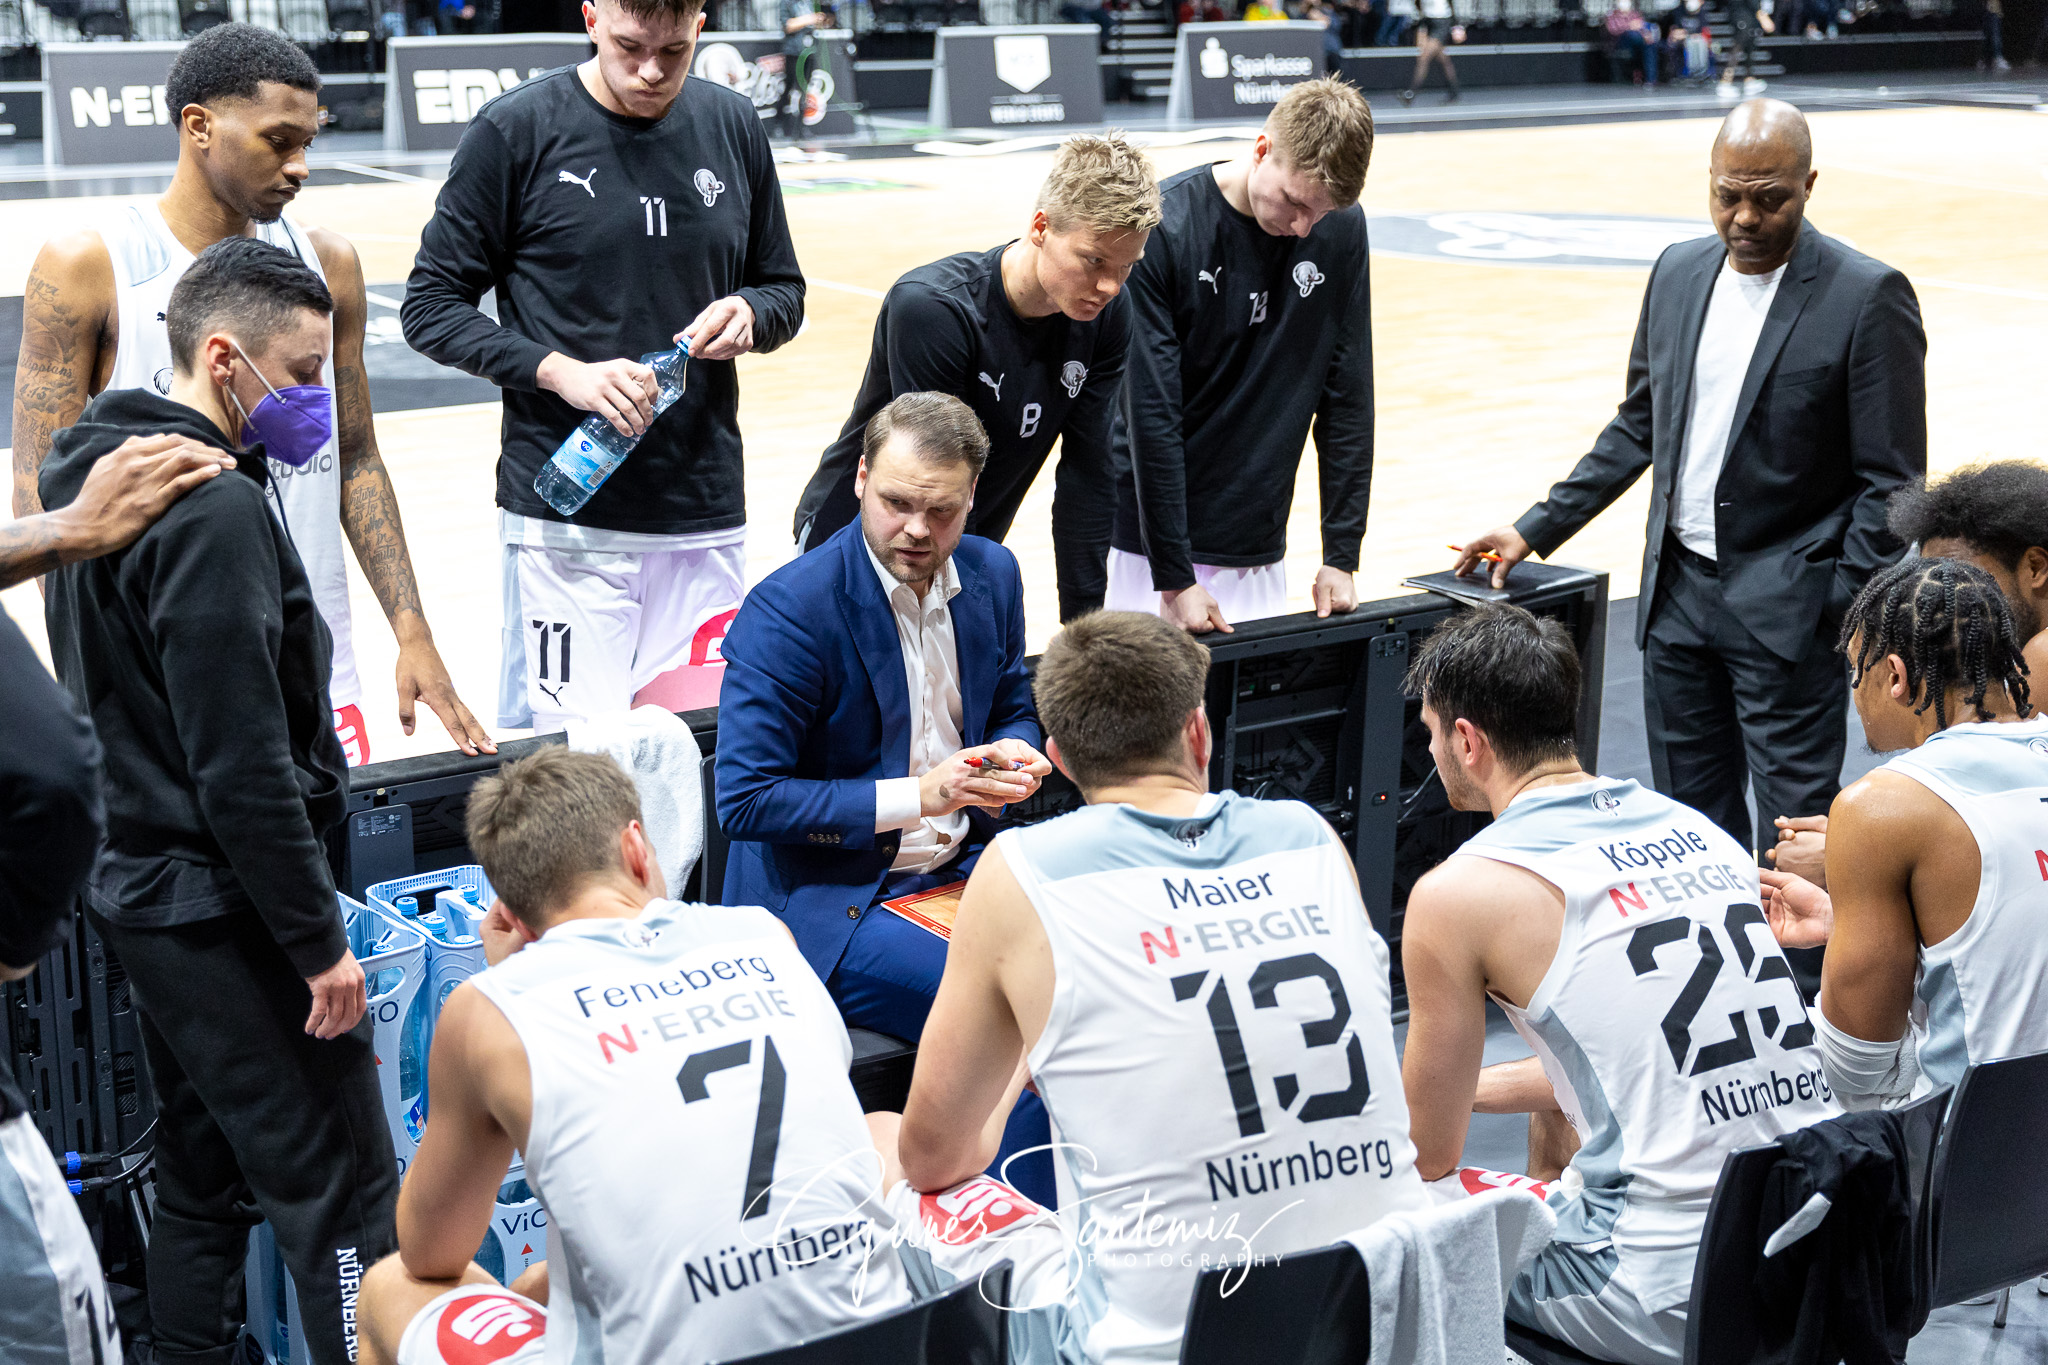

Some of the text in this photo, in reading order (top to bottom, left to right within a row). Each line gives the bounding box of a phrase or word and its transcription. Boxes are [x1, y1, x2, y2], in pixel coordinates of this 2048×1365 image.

[1231, 53, 1313, 81] Sparkasse
[639, 196, 667, 236] 11
[1019, 402, 1042, 438] 8
[532, 619, 572, 683] 11
[1598, 828, 1708, 872] Köpple
[1162, 872, 1273, 909] Maier
[573, 957, 776, 1018] Feneberg
[1170, 952, 1371, 1138] 13
[1701, 1068, 1832, 1126] Nürnberg
[676, 1035, 787, 1222] 7
[1205, 1139, 1393, 1202] Nürnberg
[684, 1220, 876, 1303] Nürnberg
